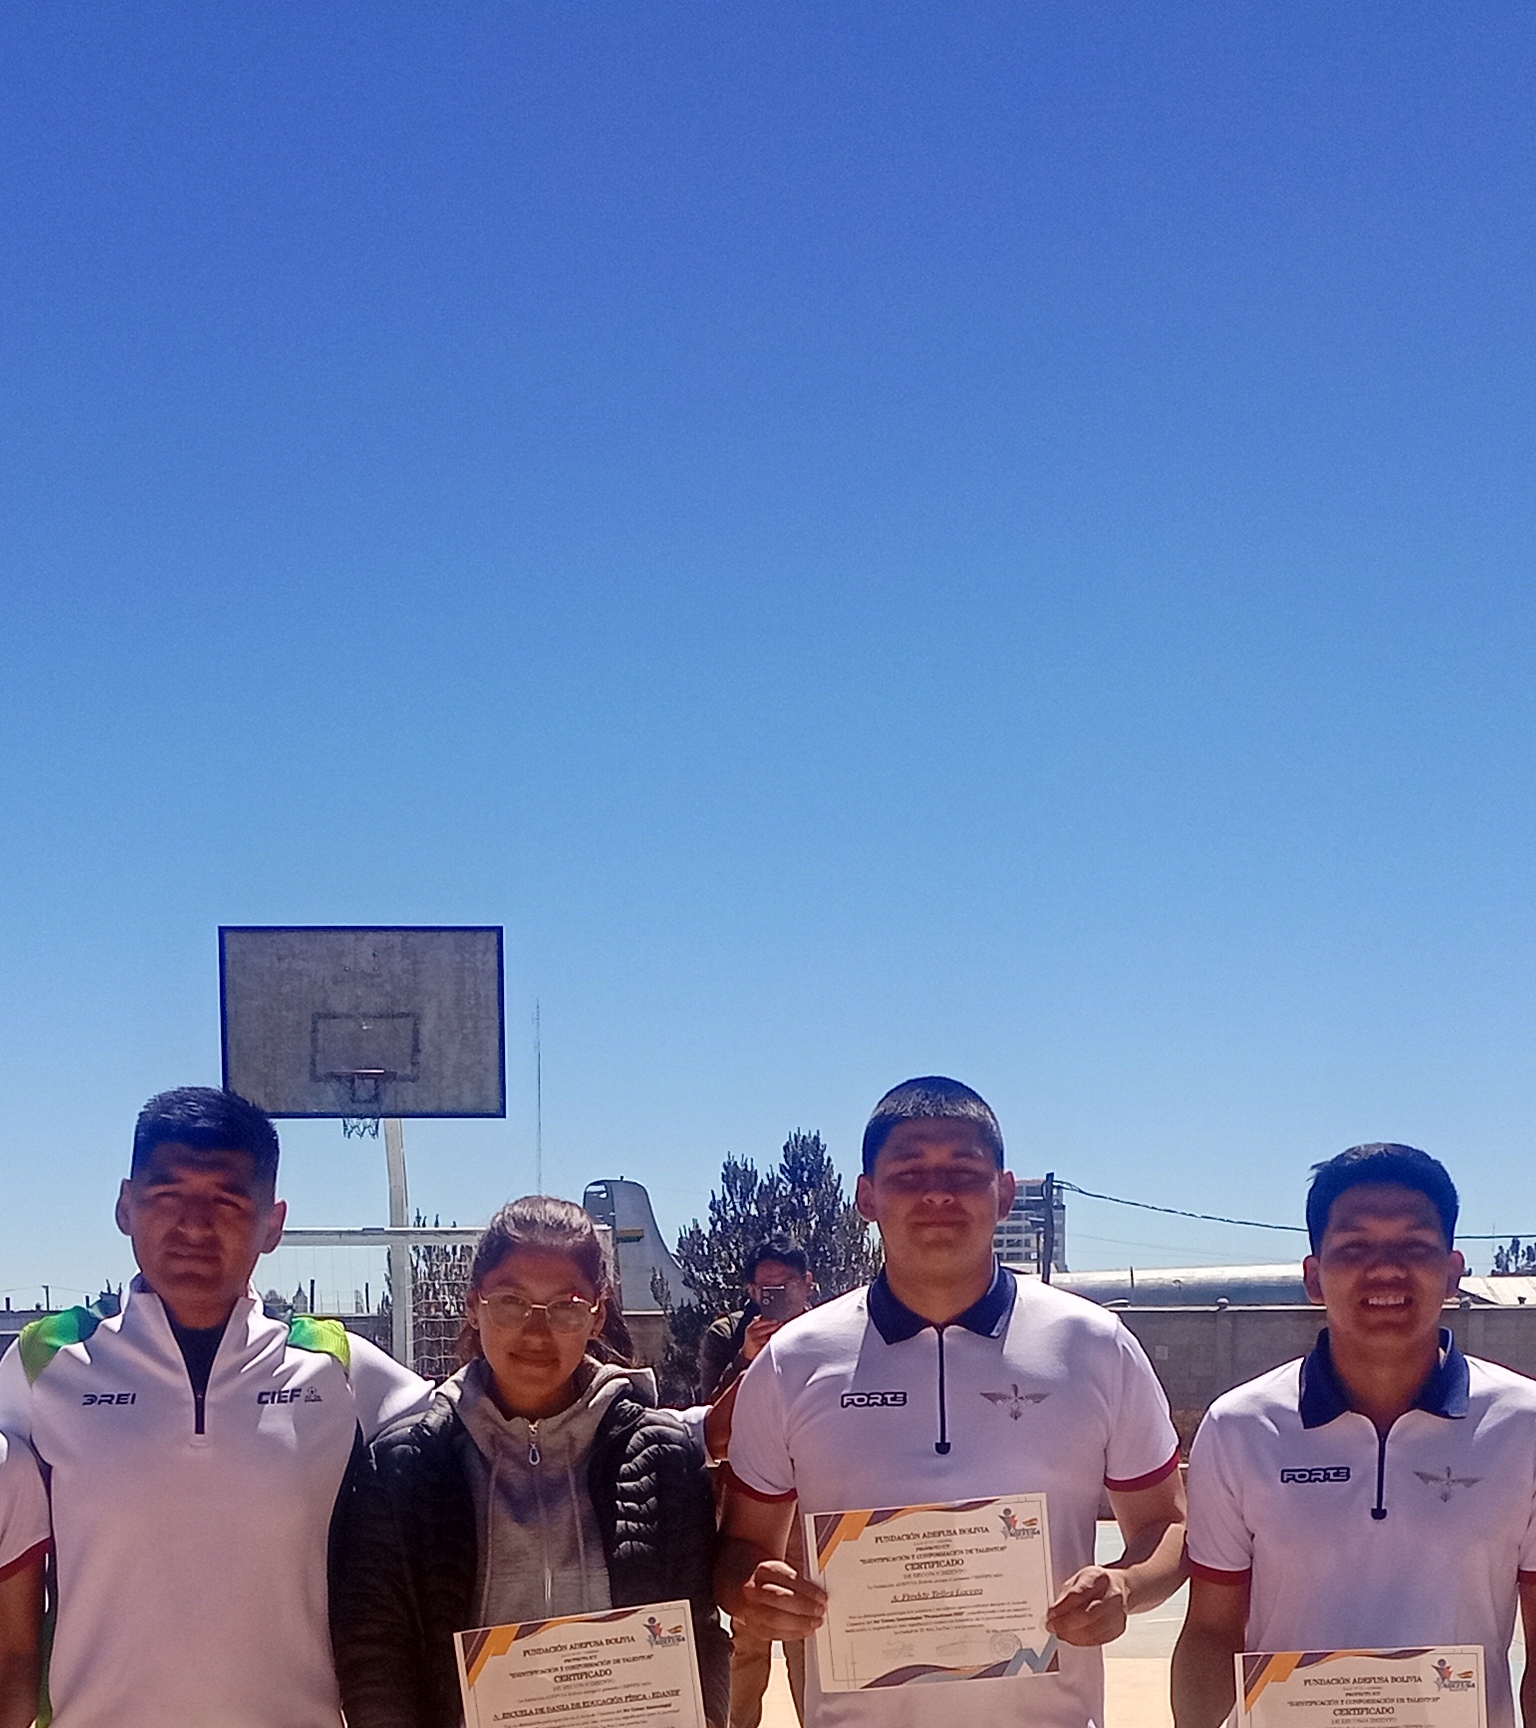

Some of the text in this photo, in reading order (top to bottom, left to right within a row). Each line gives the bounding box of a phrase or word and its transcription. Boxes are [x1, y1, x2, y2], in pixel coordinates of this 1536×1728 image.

[257, 1388, 302, 1404] CIEF
[842, 1393, 906, 1407] FORTE
[1282, 1468, 1348, 1481] FORTE
[904, 1557, 964, 1570] CERTIFICADO
[553, 1668, 612, 1683] CERTIFICADO
[1333, 1706, 1394, 1715] CERTIFICADO
